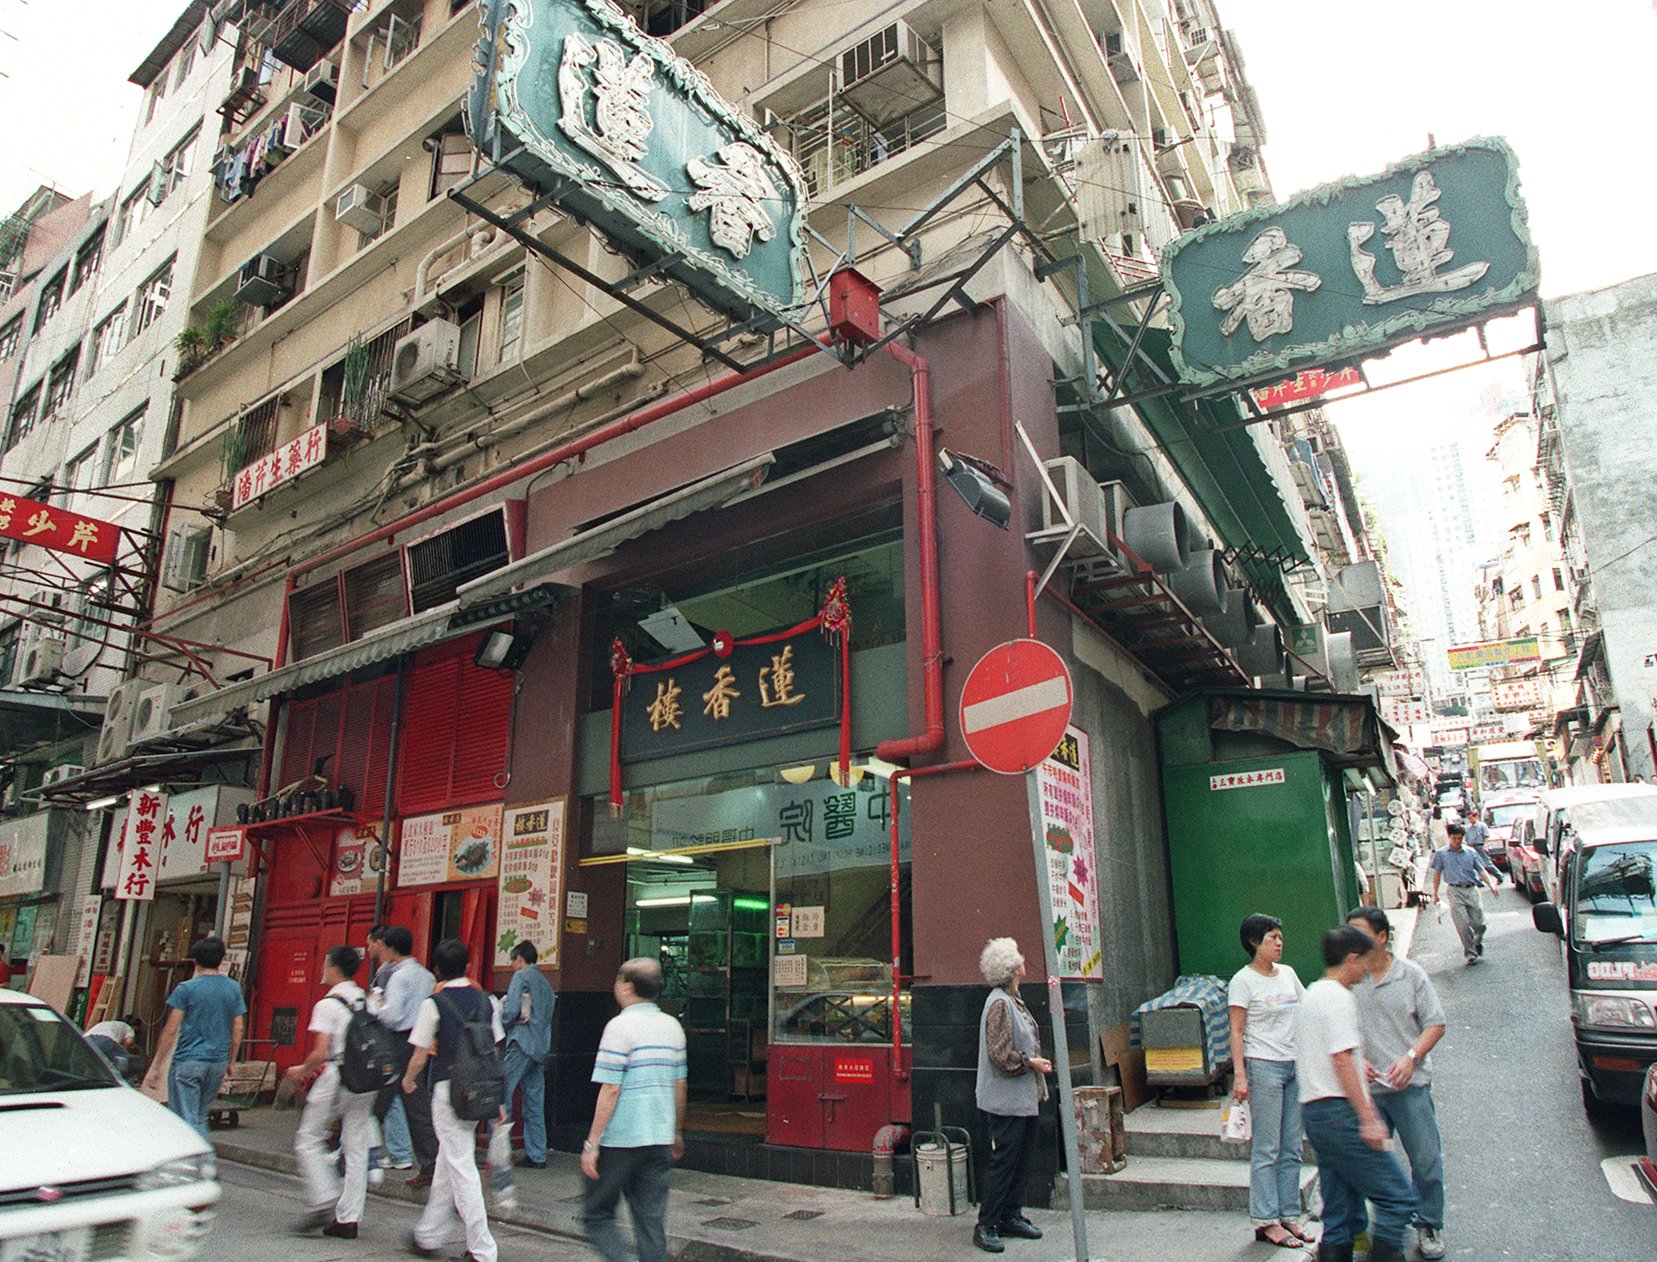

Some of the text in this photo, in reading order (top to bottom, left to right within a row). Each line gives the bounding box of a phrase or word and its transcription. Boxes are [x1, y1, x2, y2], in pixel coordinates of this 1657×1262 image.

[237, 430, 323, 503] 潘芹生藥行
[124, 793, 161, 896] 新豐木行
